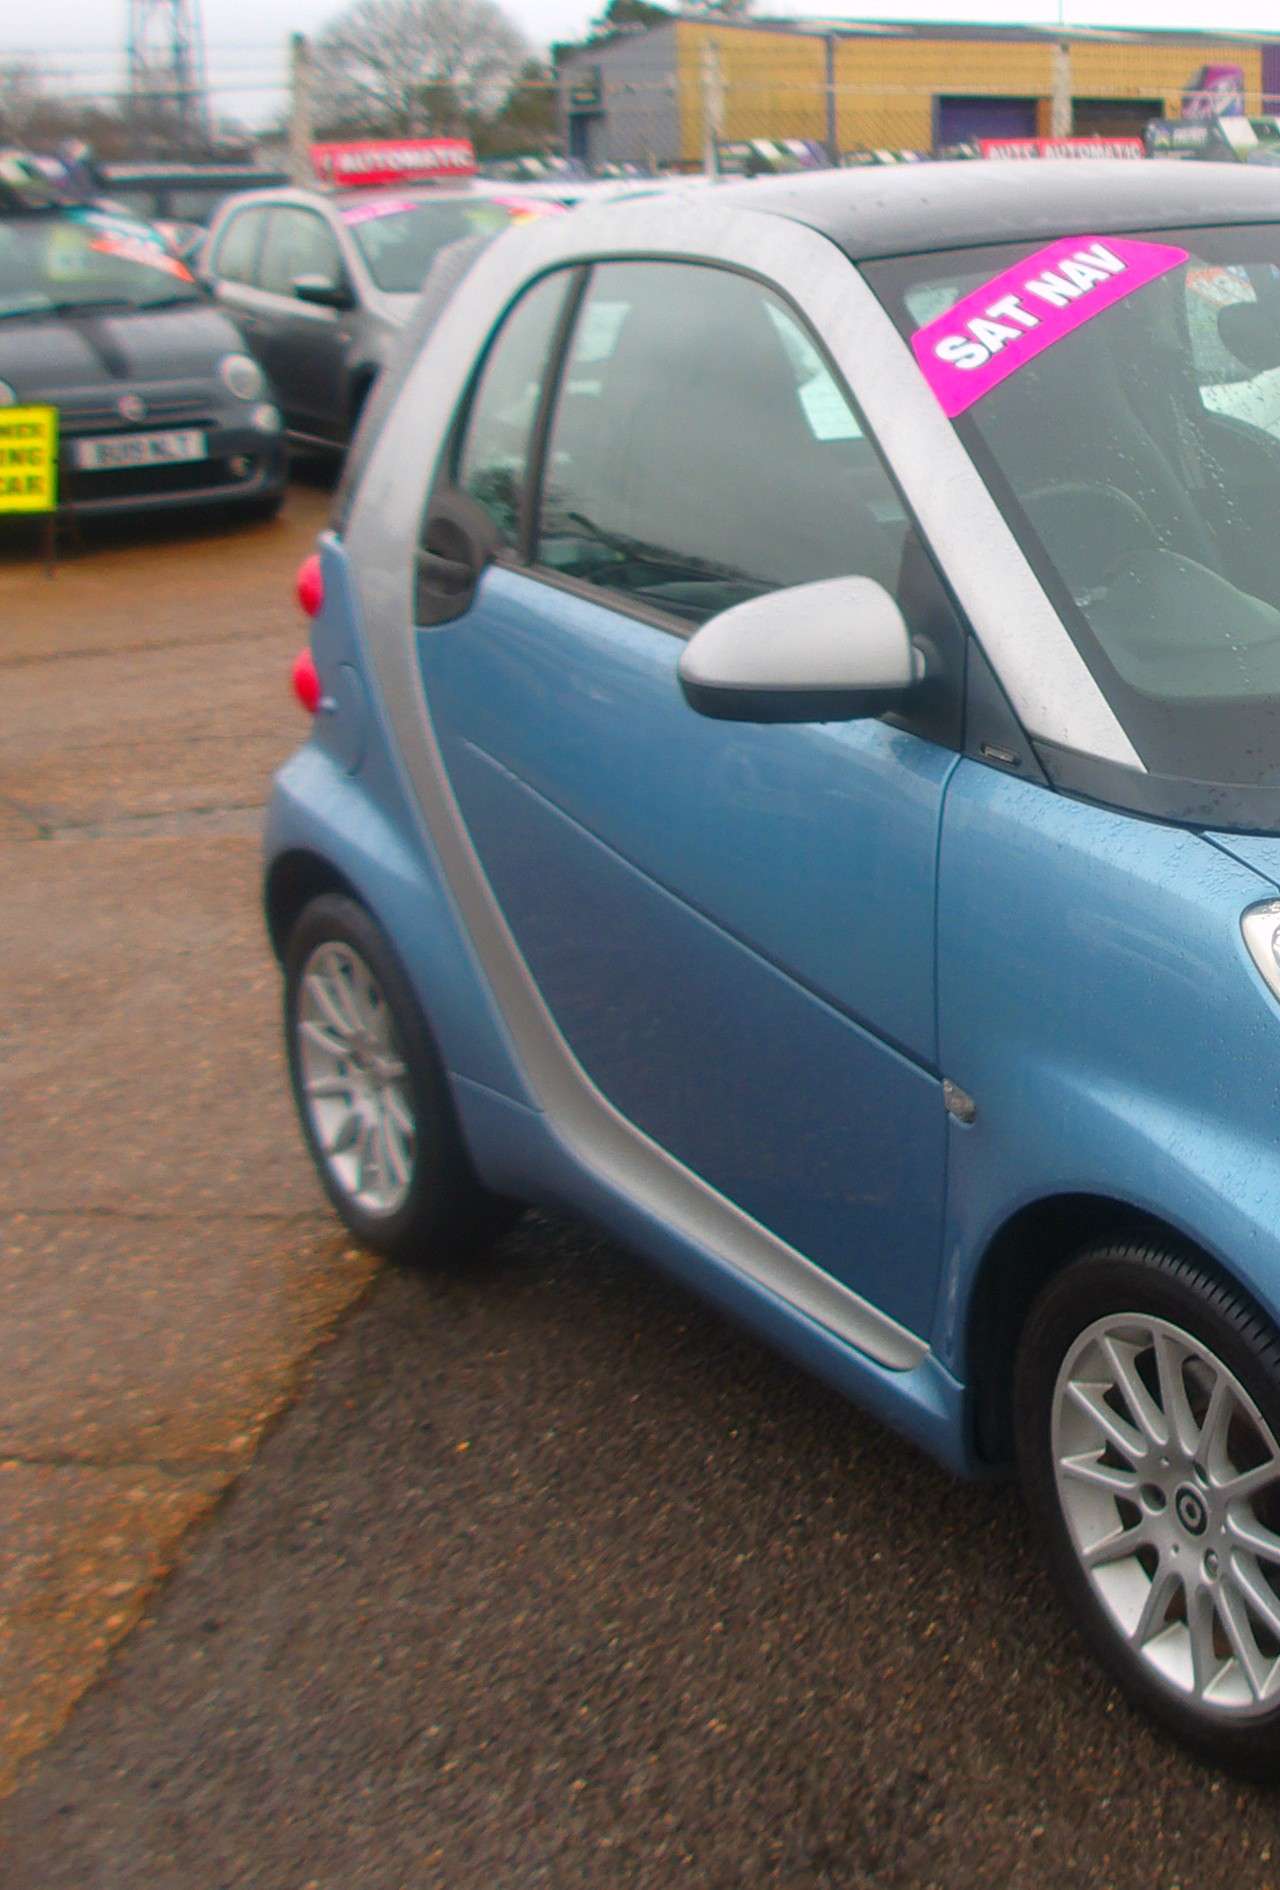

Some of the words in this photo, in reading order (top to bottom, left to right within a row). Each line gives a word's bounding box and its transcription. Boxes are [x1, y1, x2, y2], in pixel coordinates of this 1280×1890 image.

[338, 145, 474, 171] AUTOMATIC
[935, 295, 1043, 370] SAT
[1024, 243, 1128, 308] NAV
[0, 447, 45, 466] ING
